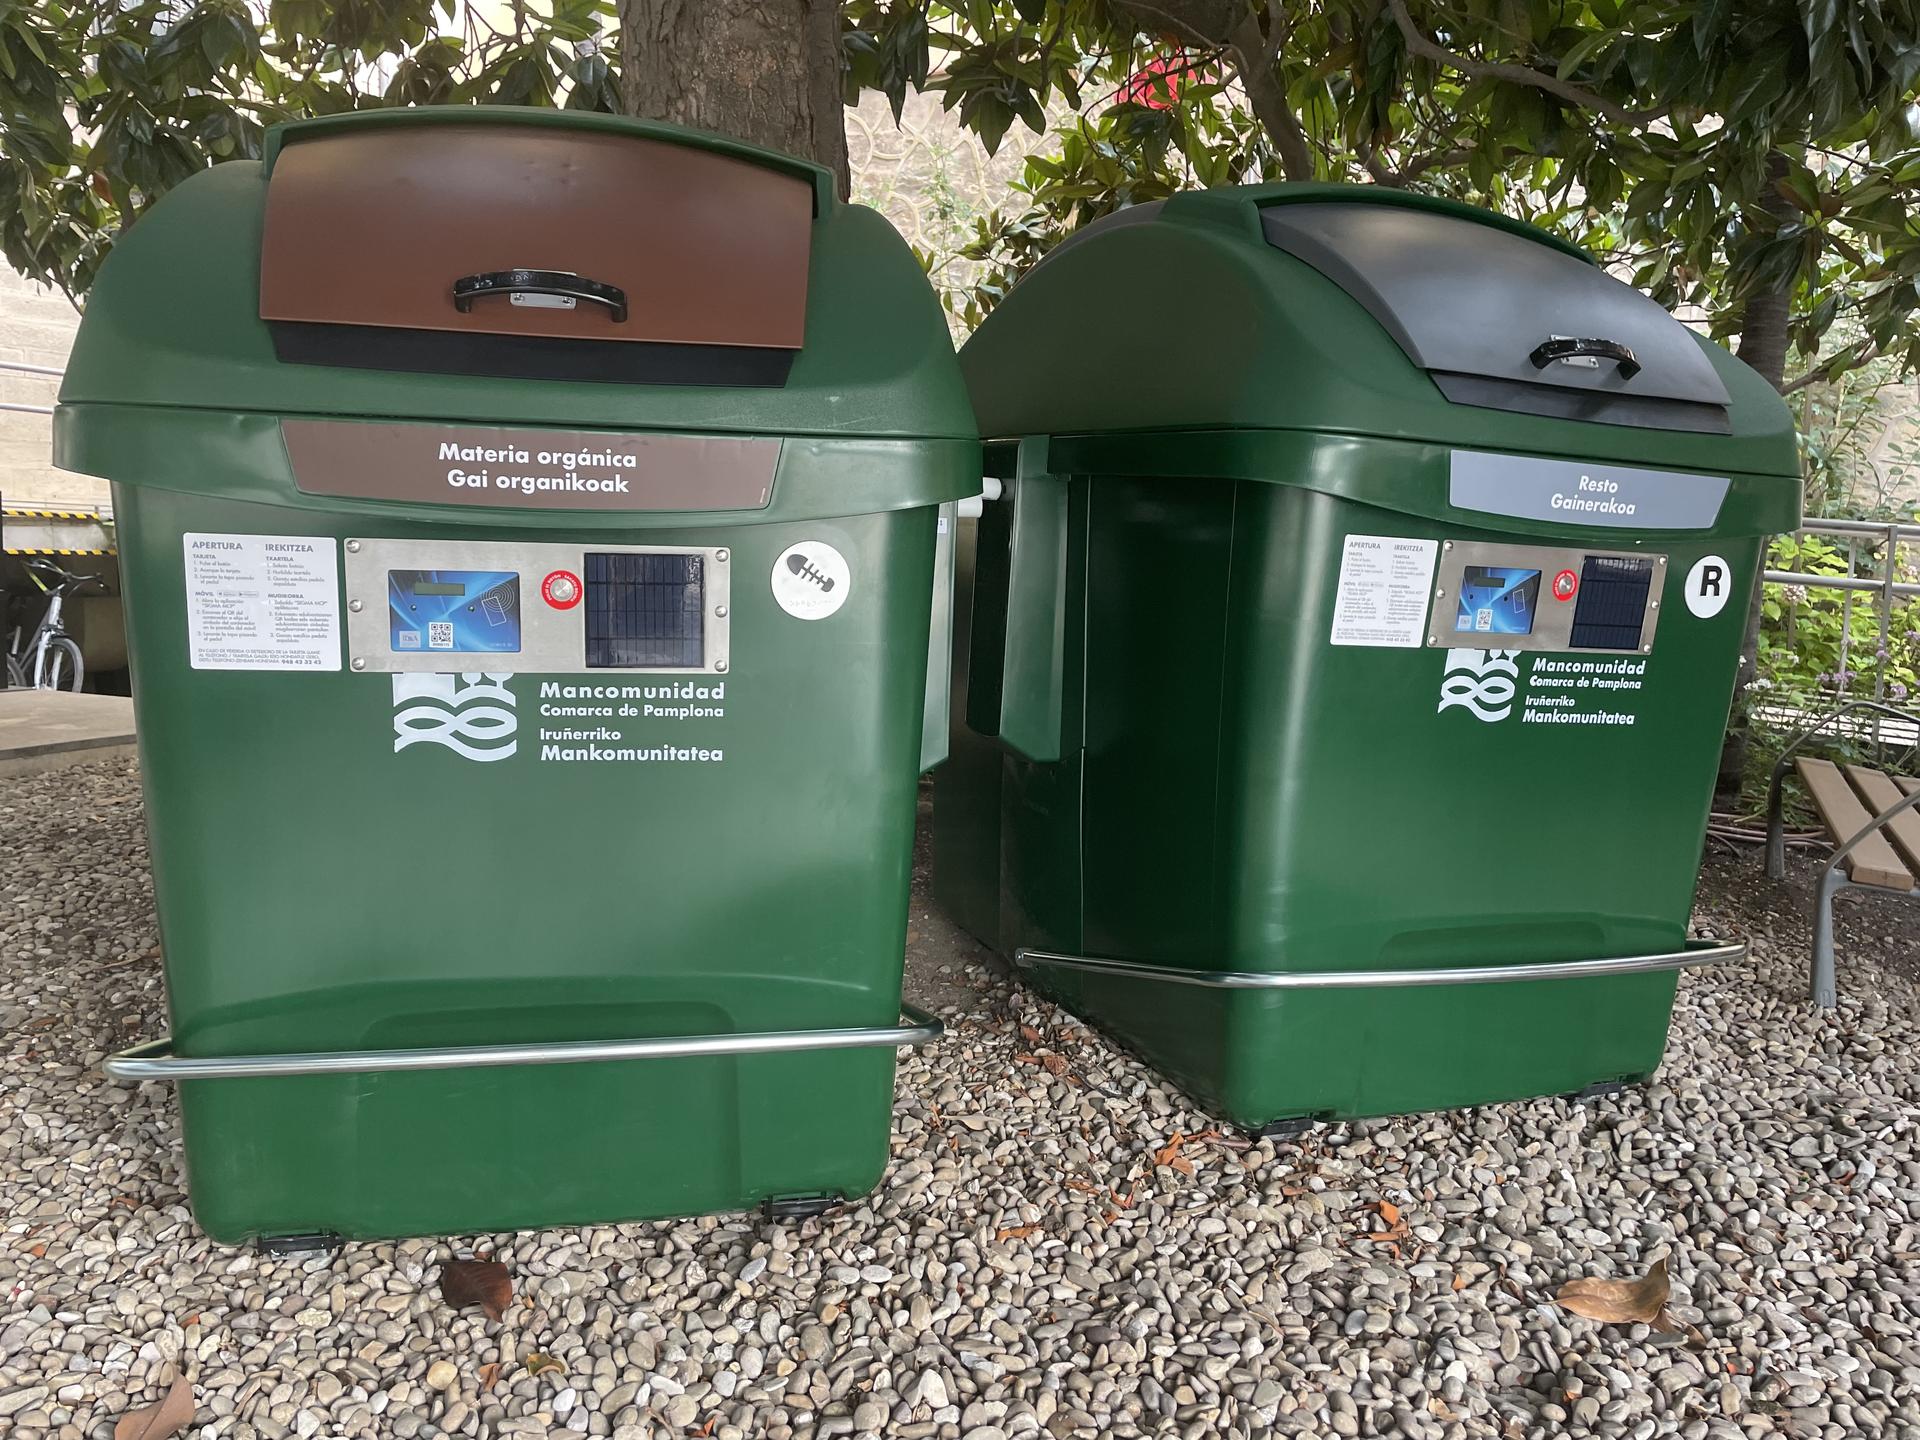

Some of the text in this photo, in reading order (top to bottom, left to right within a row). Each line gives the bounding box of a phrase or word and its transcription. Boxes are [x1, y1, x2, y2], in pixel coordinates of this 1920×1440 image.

[438, 442, 637, 471] Materia orgánica
[447, 469, 630, 495] Gai organikoak
[1578, 475, 1619, 493] Resto
[1550, 494, 1636, 516] Gainerakoa
[192, 541, 243, 550] APERTURA
[265, 543, 314, 552] IREKITZEA
[1349, 541, 1382, 549] APERTURA
[1394, 544, 1424, 552] IREKITZEA
[1700, 565, 1722, 597] R
[1532, 658, 1646, 675] Mancomunidad
[540, 682, 725, 699] Mancomunidad
[1529, 675, 1642, 692] Comarca de Pamplona
[1525, 695, 1576, 707] Iruñerriko
[540, 703, 724, 720] Comarca de Pamplona
[1522, 708, 1635, 725] Mankomunitatea
[540, 727, 622, 741] Iruñerriko
[541, 743, 723, 761] Mankomunitatea
